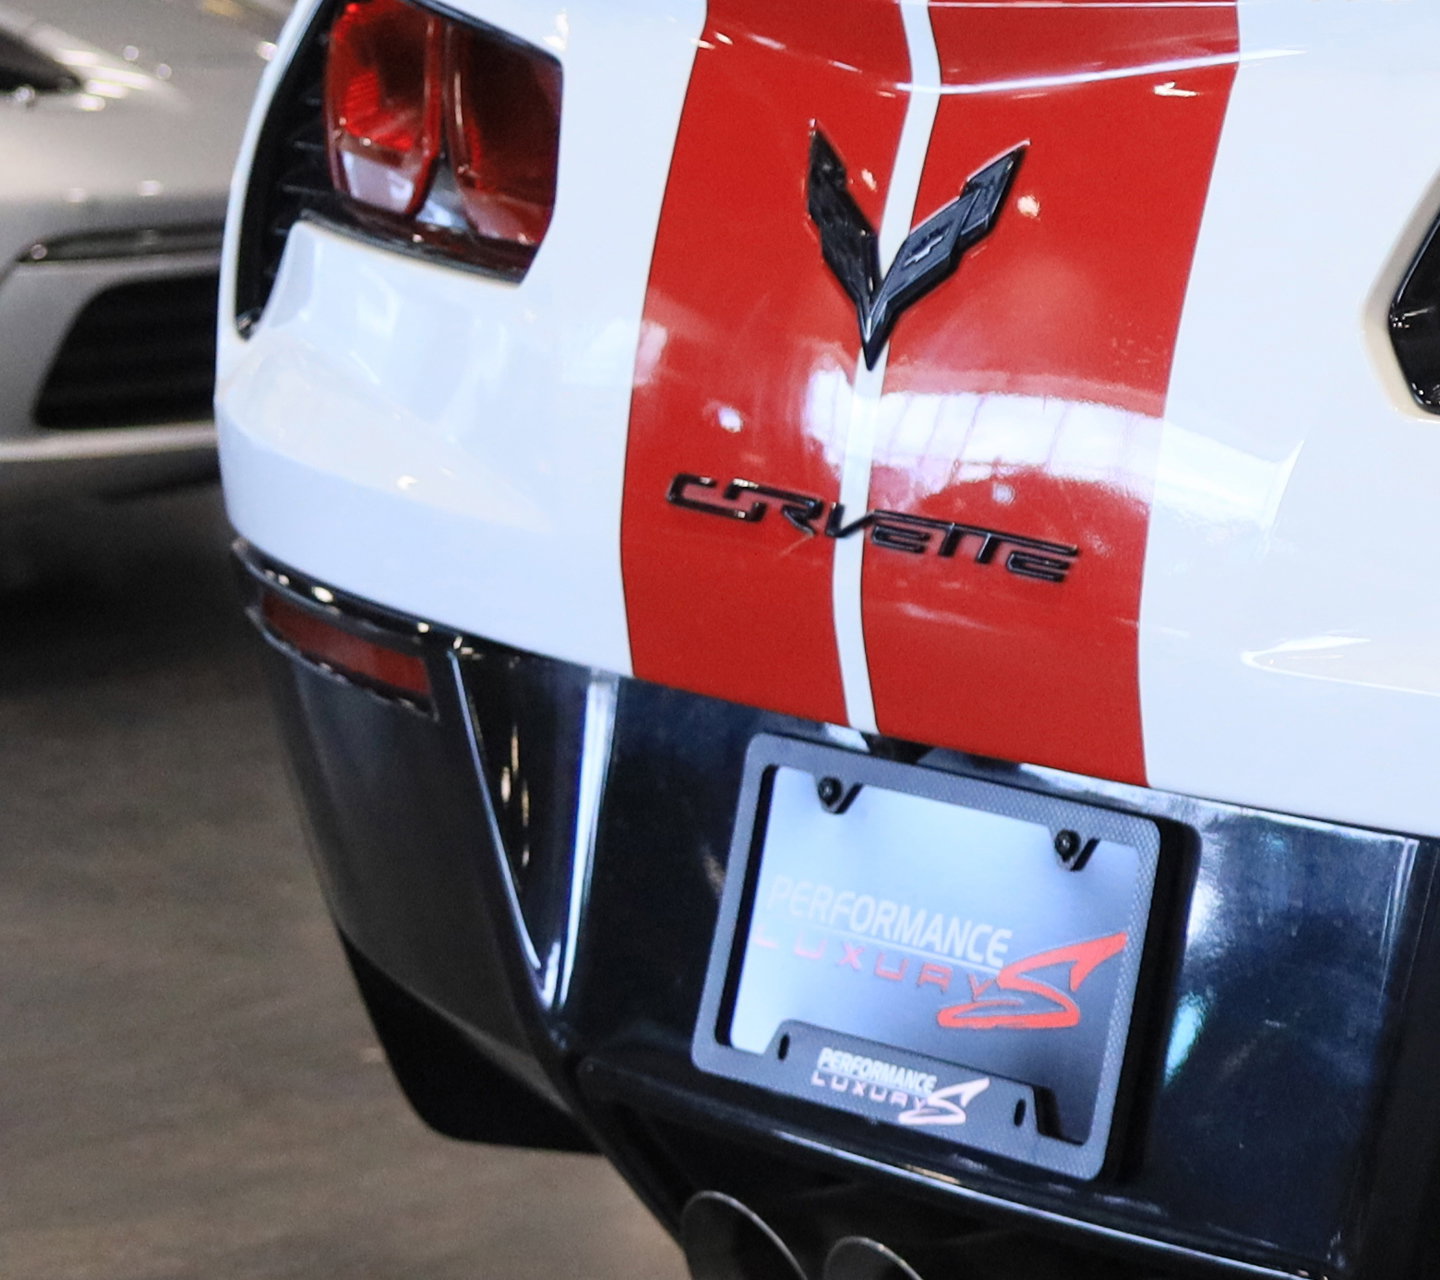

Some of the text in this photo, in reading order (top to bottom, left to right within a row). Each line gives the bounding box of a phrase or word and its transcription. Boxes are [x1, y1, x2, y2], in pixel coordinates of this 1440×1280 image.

[765, 874, 1014, 969] PERFORMANCE
[753, 923, 1001, 1001] LUXURY
[810, 1071, 930, 1111] LUXURY
[816, 1046, 938, 1094] PERFORMANCE
